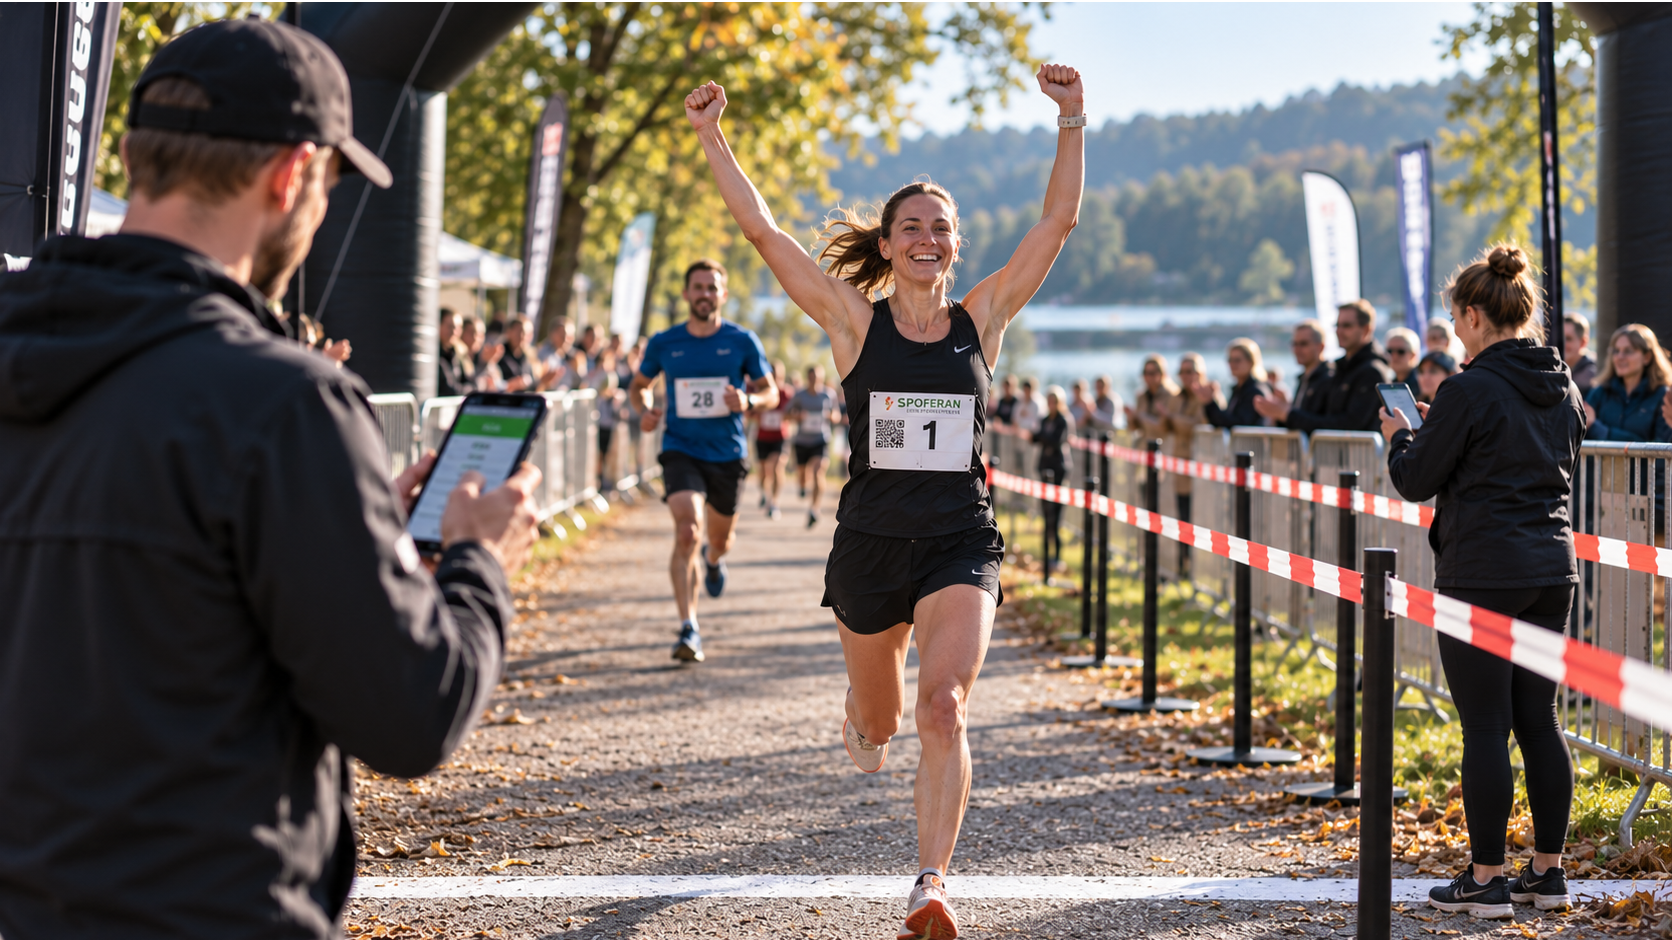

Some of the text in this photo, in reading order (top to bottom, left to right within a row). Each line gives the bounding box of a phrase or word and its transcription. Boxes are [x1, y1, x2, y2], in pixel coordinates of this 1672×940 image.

[692, 391, 714, 408] 28
[897, 397, 961, 409] SPOFERAN
[922, 420, 937, 450] 1
